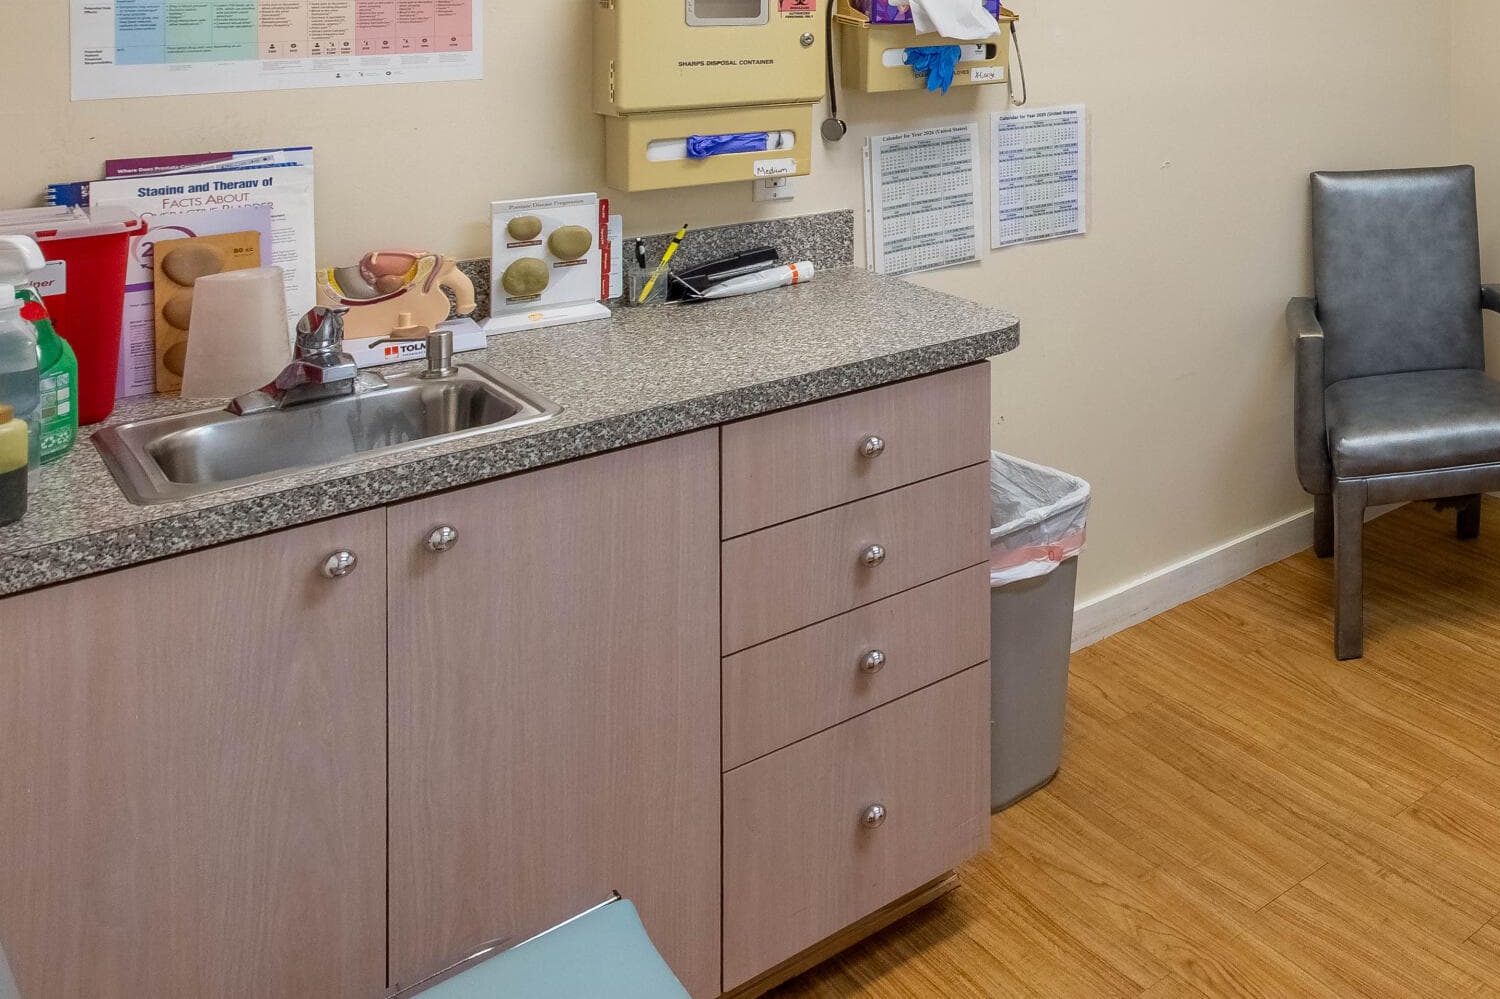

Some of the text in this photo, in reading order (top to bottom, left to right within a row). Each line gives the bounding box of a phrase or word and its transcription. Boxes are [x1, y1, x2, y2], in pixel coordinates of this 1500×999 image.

[757, 166, 787, 175] Medium
[188, 182, 210, 194] and
[262, 176, 273, 187] of
[162, 198, 202, 210] FACTS
[205, 192, 250, 206] ABOUT
